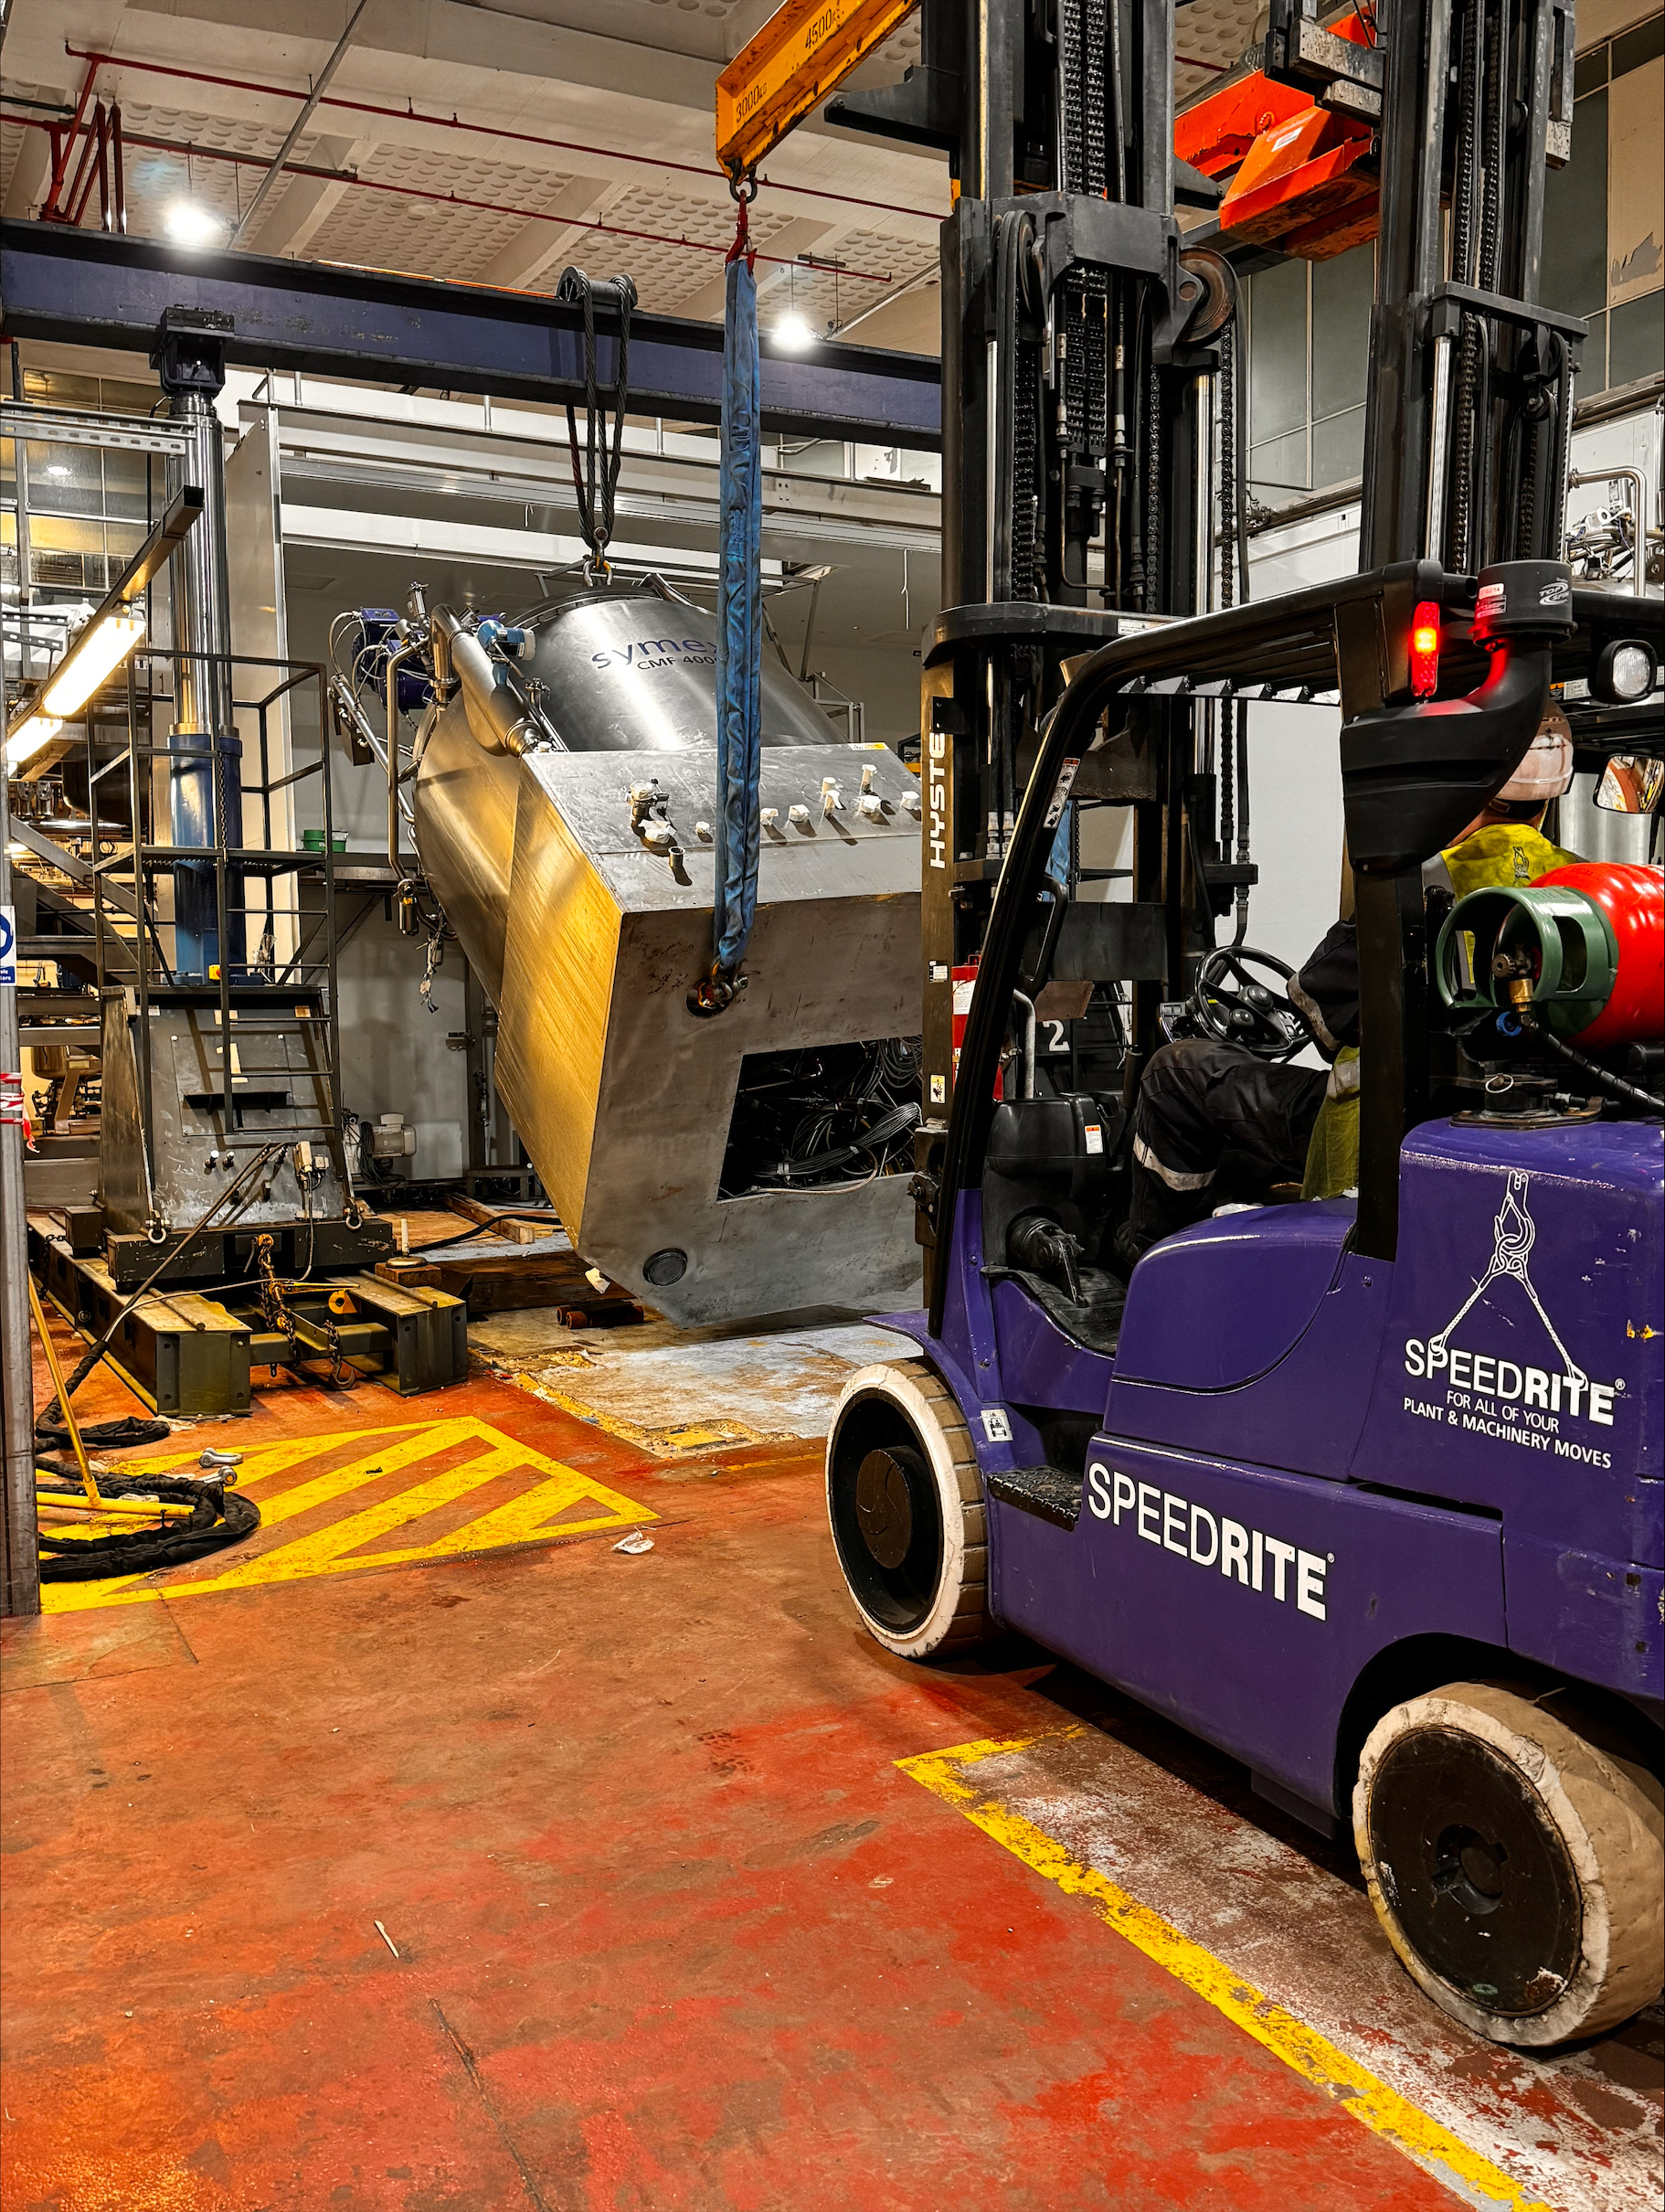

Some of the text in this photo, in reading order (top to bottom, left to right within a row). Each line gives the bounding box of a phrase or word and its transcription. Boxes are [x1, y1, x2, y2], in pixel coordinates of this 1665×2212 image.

[1539, 586, 1561, 597] TOP
[637, 655, 716, 670] CMF 400
[928, 709, 946, 868] HYSTE
[1043, 1019, 1070, 1051] 2
[1446, 1389, 1560, 1434] FOR ALL OF YOUR
[1404, 1397, 1612, 1470] PLANT & MACHINERY MOVES
